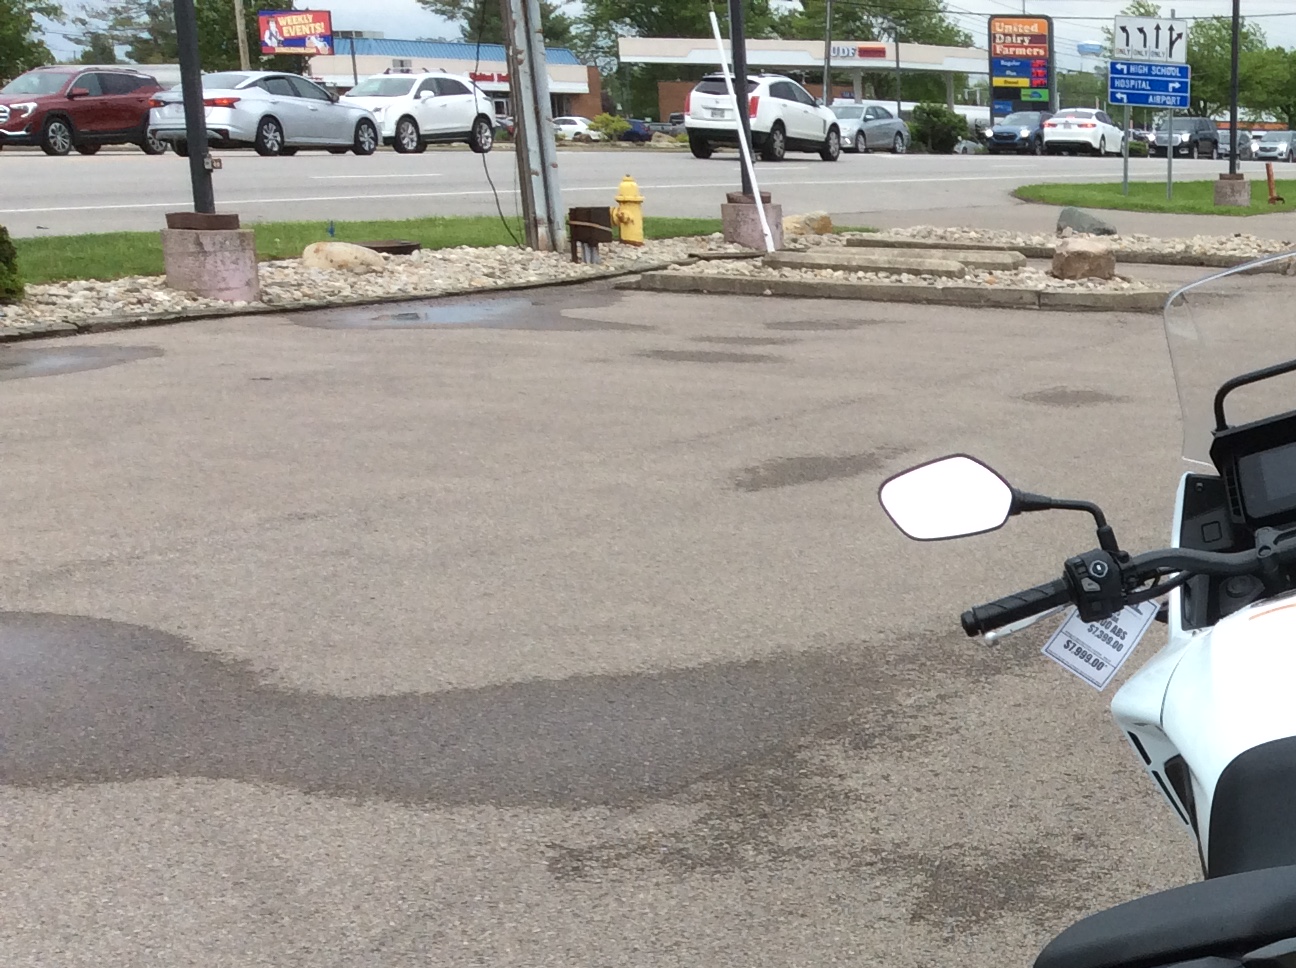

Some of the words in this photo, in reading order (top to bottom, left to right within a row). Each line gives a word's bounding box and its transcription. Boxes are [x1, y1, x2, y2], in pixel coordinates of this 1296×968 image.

[278, 14, 313, 26] WEEKLY
[282, 22, 325, 37] EVENTS!
[994, 22, 1038, 33] United
[995, 34, 1031, 46] Dairy
[831, 46, 856, 57] UDF
[995, 45, 1045, 55] Farmers
[1130, 65, 1148, 74] HIGH
[1151, 66, 1181, 76] SCHOOL
[1115, 79, 1151, 90] HOSPITAL
[1148, 95, 1181, 105] AIRPORT
[1110, 624, 1128, 640] ABS
